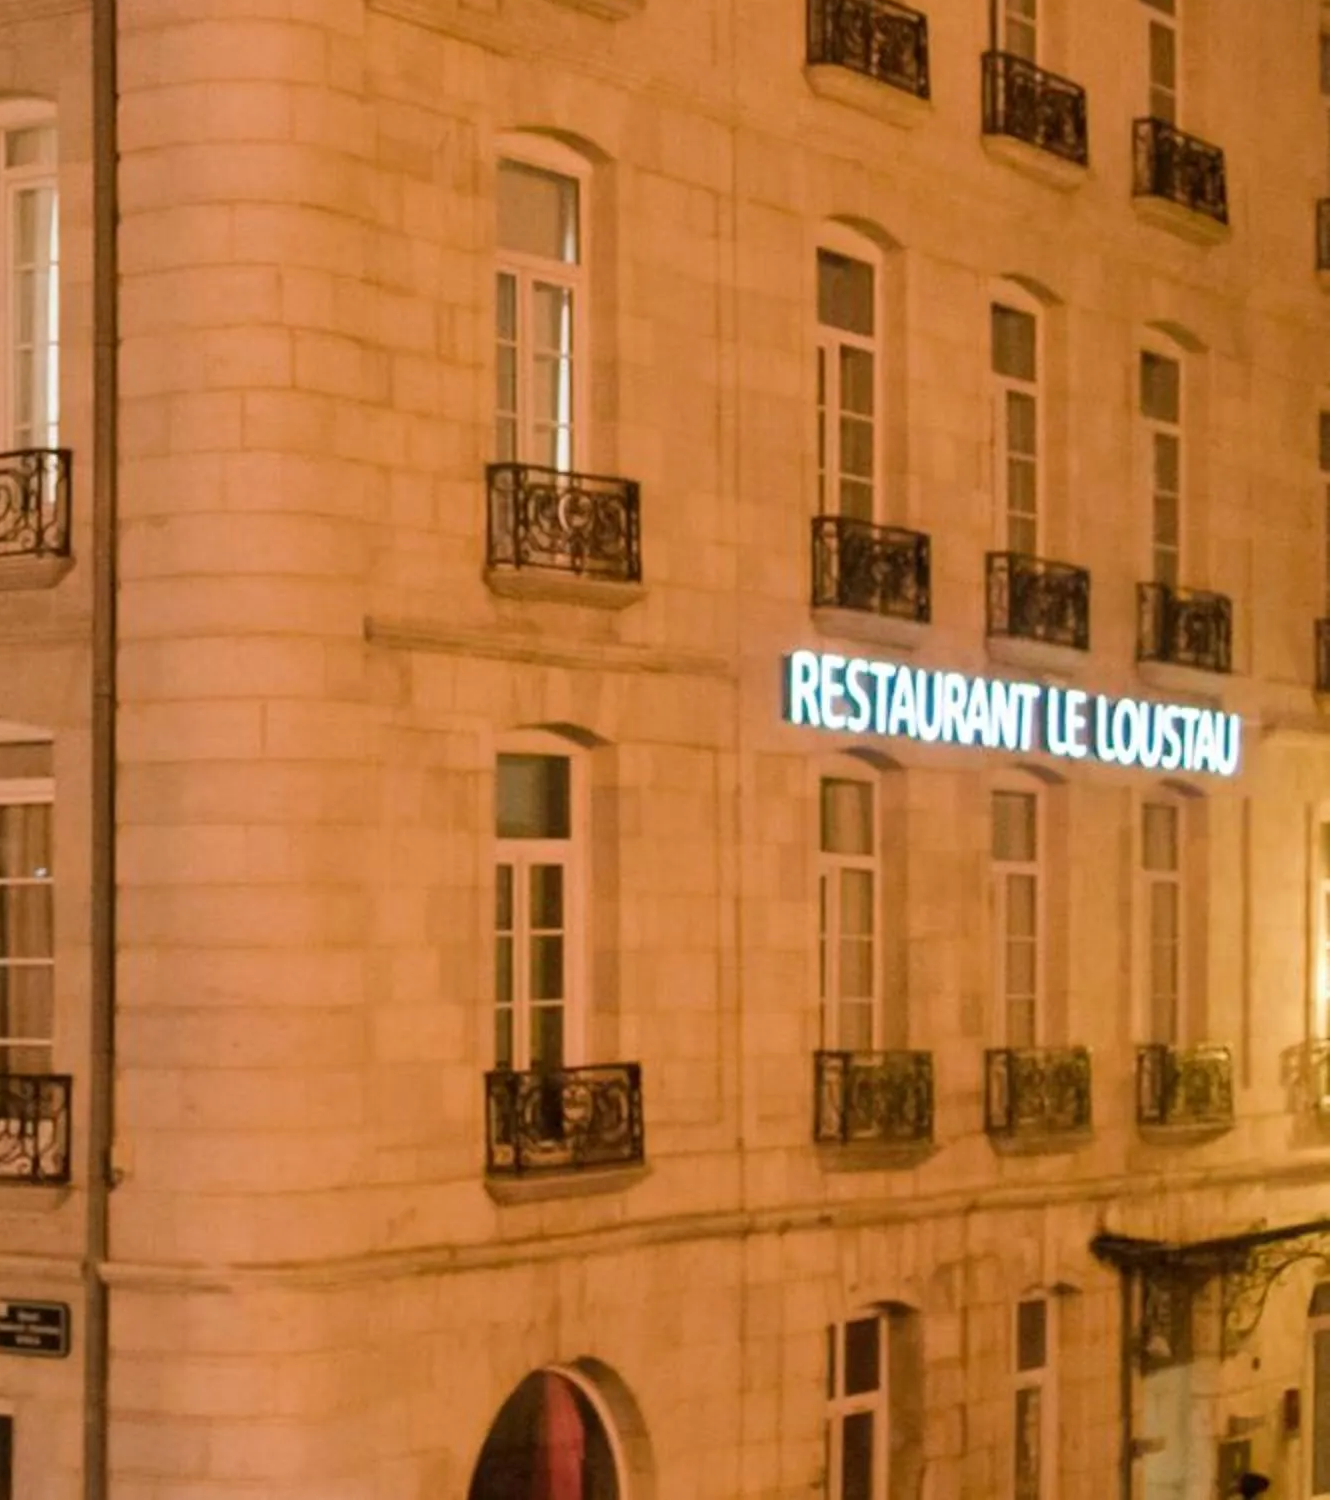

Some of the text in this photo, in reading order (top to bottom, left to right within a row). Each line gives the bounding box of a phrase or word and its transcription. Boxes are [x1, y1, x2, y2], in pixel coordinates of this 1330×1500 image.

[791, 650, 1241, 776] RESTAURANT LE LOUSTAU
